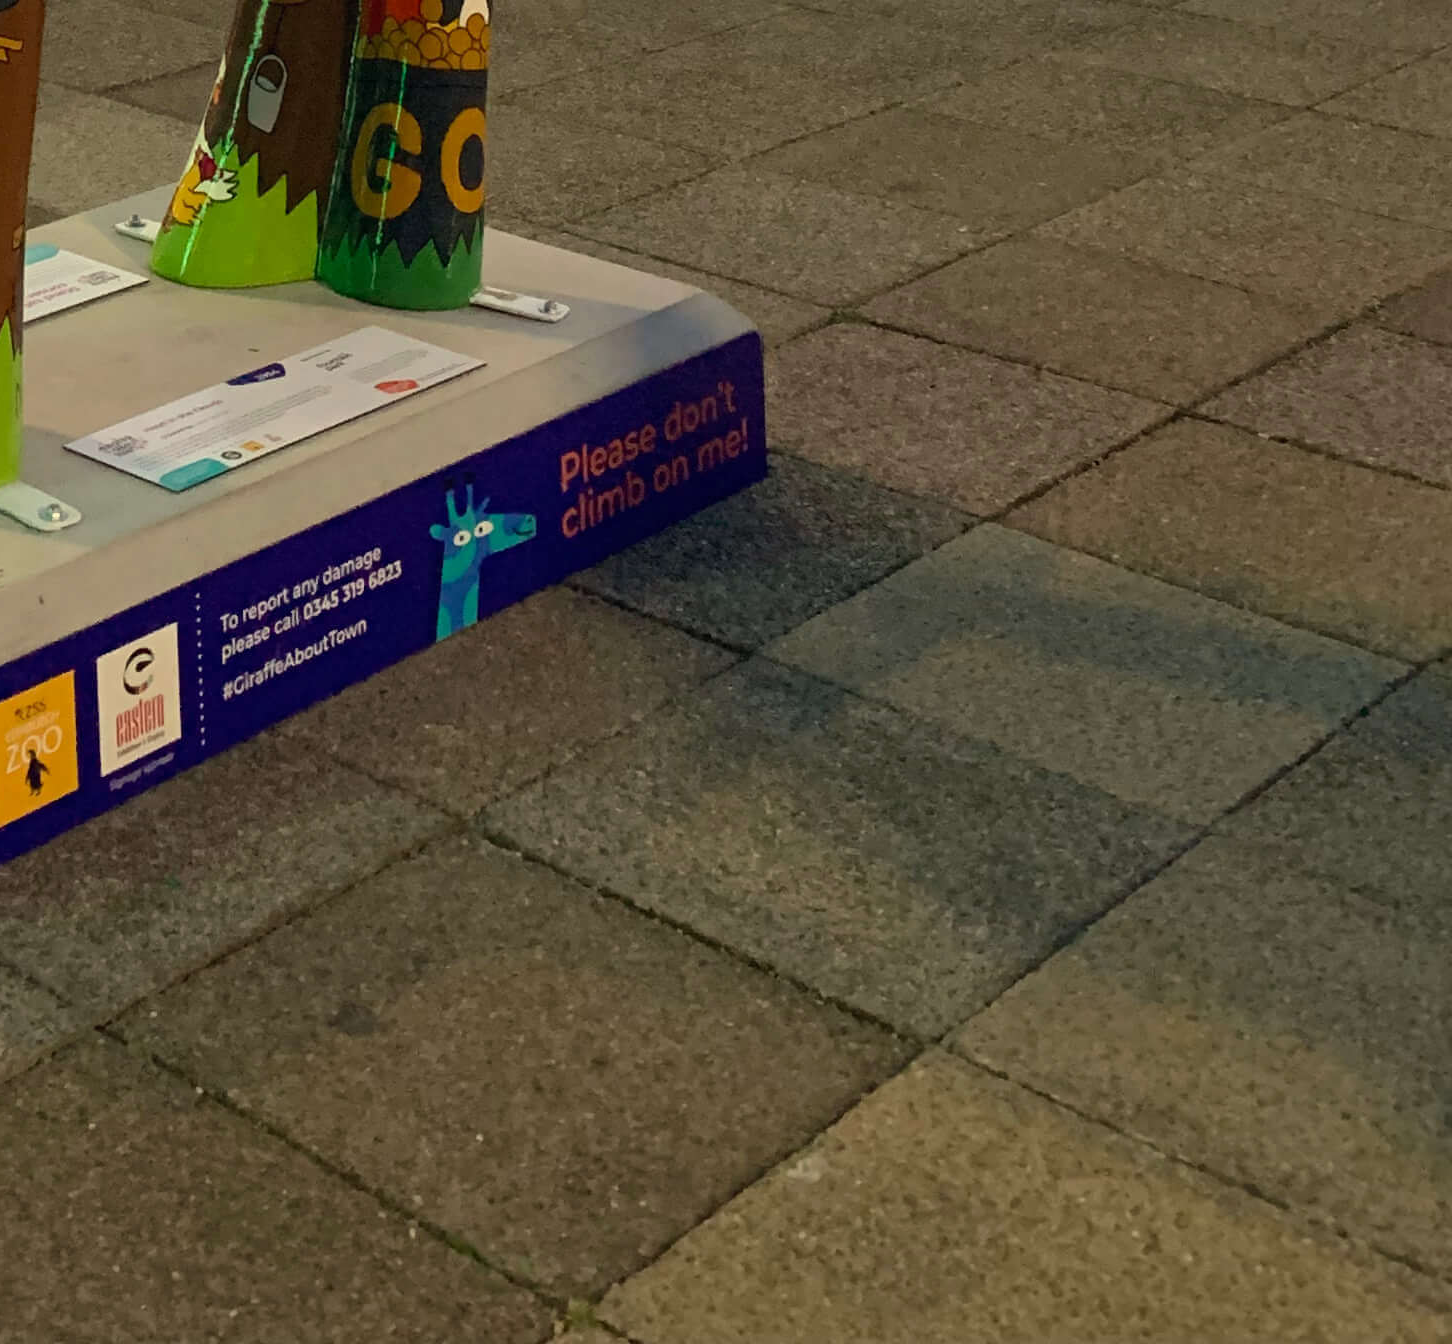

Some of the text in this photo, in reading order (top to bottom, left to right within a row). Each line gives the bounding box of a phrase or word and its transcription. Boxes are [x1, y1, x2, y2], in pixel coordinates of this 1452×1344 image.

[560, 380, 737, 493] Please don't
[562, 417, 749, 539] climb on me!
[220, 547, 382, 632] To report any damage
[221, 559, 403, 665] please call 0345 319 6823
[222, 619, 368, 702] #GiraffeAboutTown
[6, 725, 63, 775] ZOO
[116, 693, 165, 749] eastern
